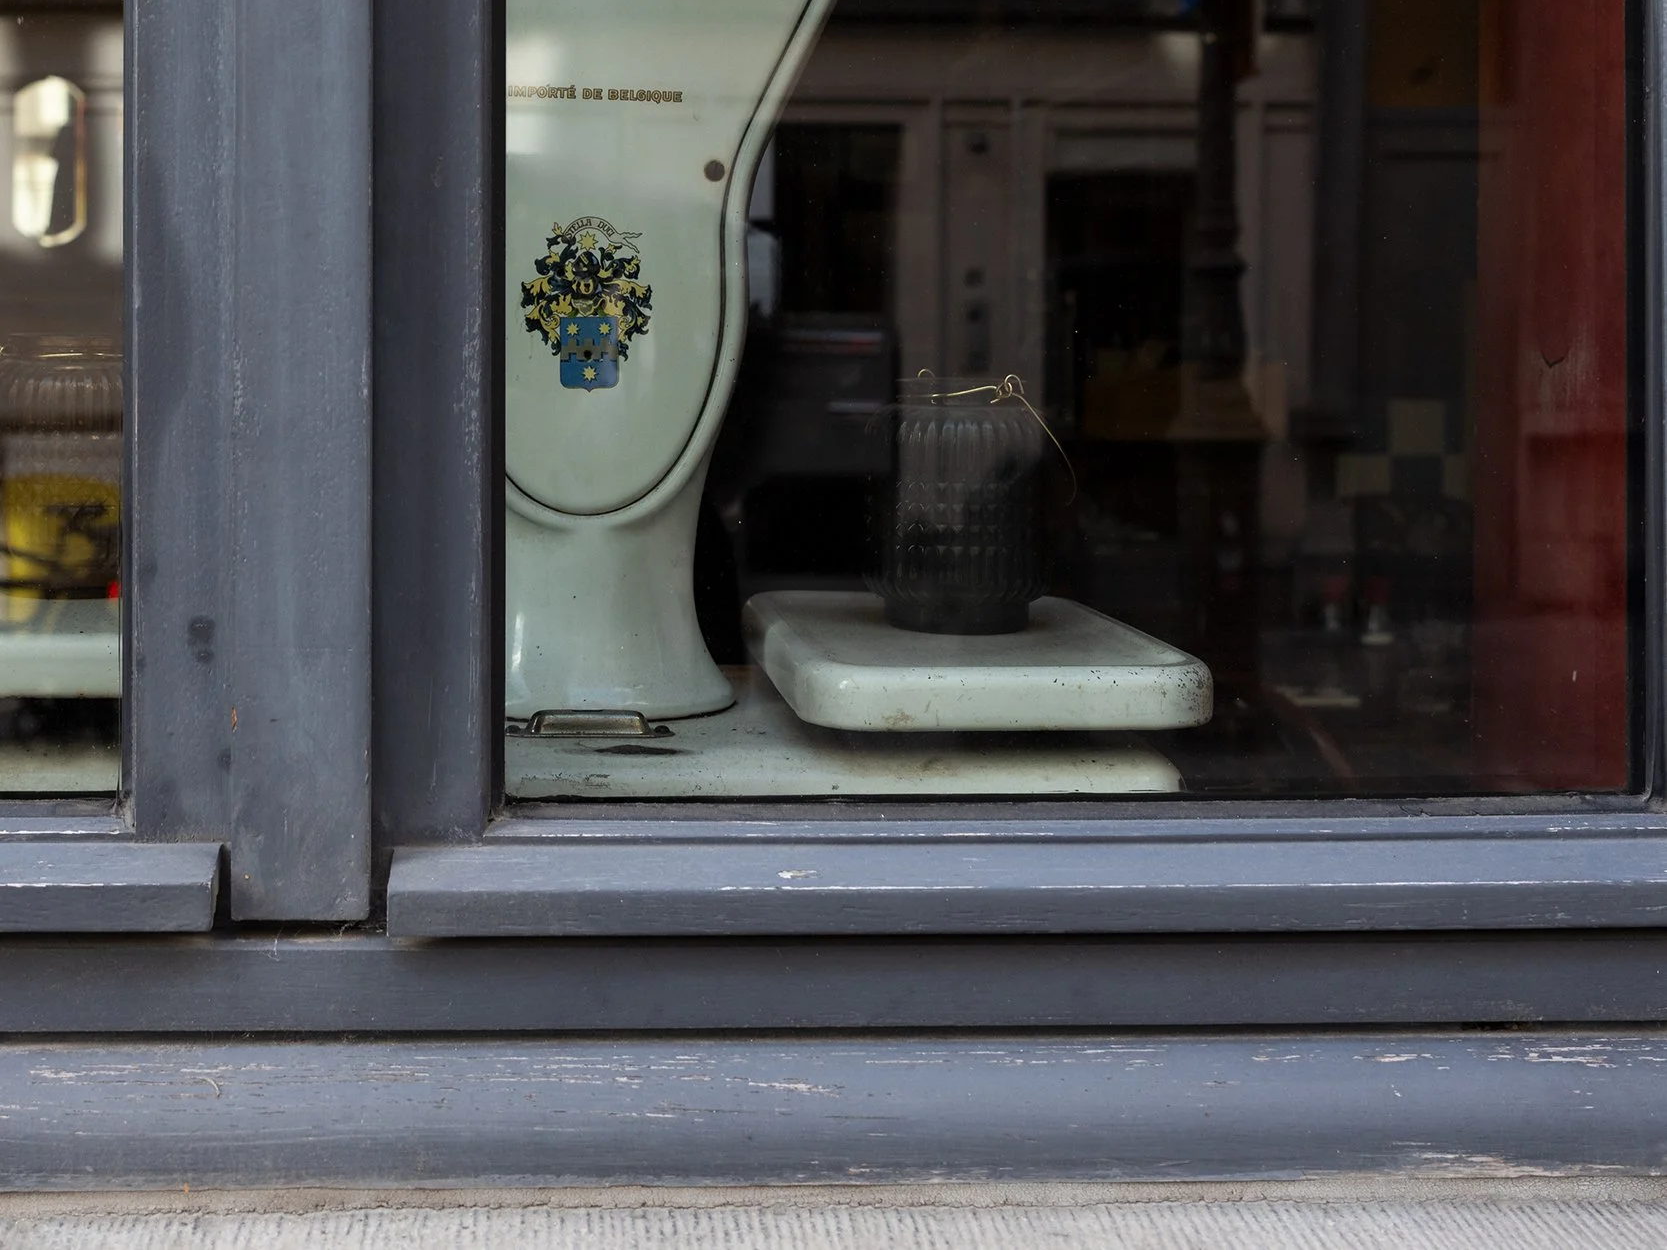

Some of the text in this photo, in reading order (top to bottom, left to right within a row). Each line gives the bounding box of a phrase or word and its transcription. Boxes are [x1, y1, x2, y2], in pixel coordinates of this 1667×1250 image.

[508, 85, 683, 104] IMPORTÉ DE BELGIQUE
